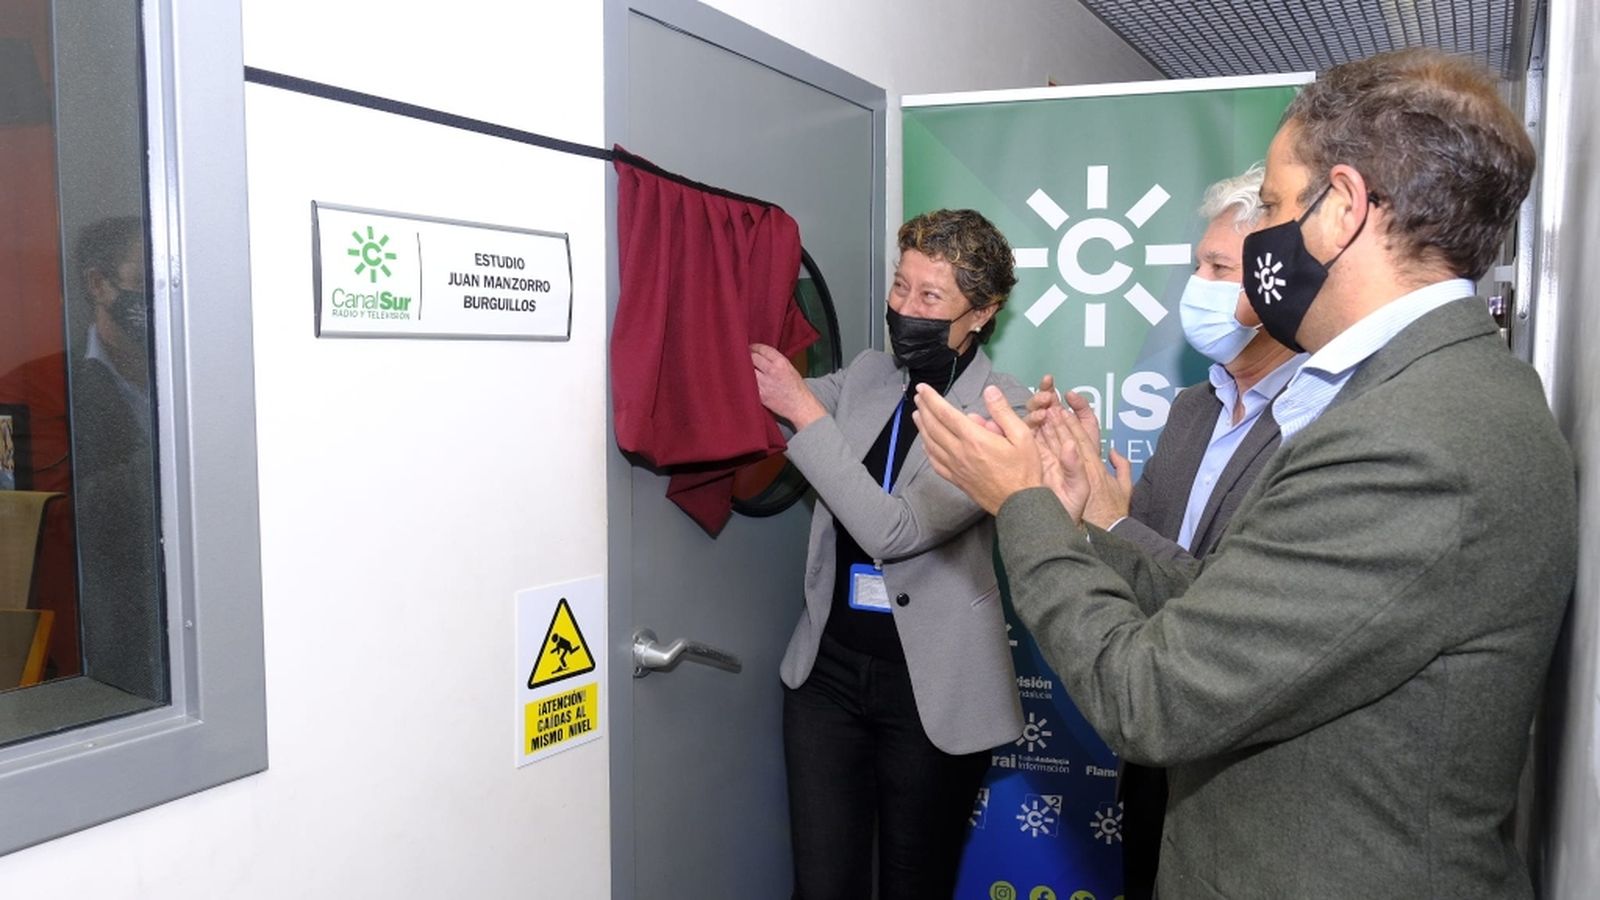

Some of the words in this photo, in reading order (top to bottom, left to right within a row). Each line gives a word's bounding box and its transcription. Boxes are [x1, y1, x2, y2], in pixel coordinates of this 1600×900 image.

[474, 252, 525, 270] ESTUDIO
[447, 271, 480, 287] JUAN
[483, 274, 551, 293] MANZORRO
[332, 287, 412, 311] CanalSur
[463, 295, 537, 312] BURGUILLOS
[332, 308, 358, 318] RADIO
[360, 310, 365, 318] Y
[367, 310, 410, 320] TELEVISIÓN
[576, 705, 586, 719] AL
[531, 728, 563, 752] MISMO
[568, 718, 592, 738] NIVEL
[991, 754, 1017, 768] rai
[1050, 796, 1061, 809] 2
